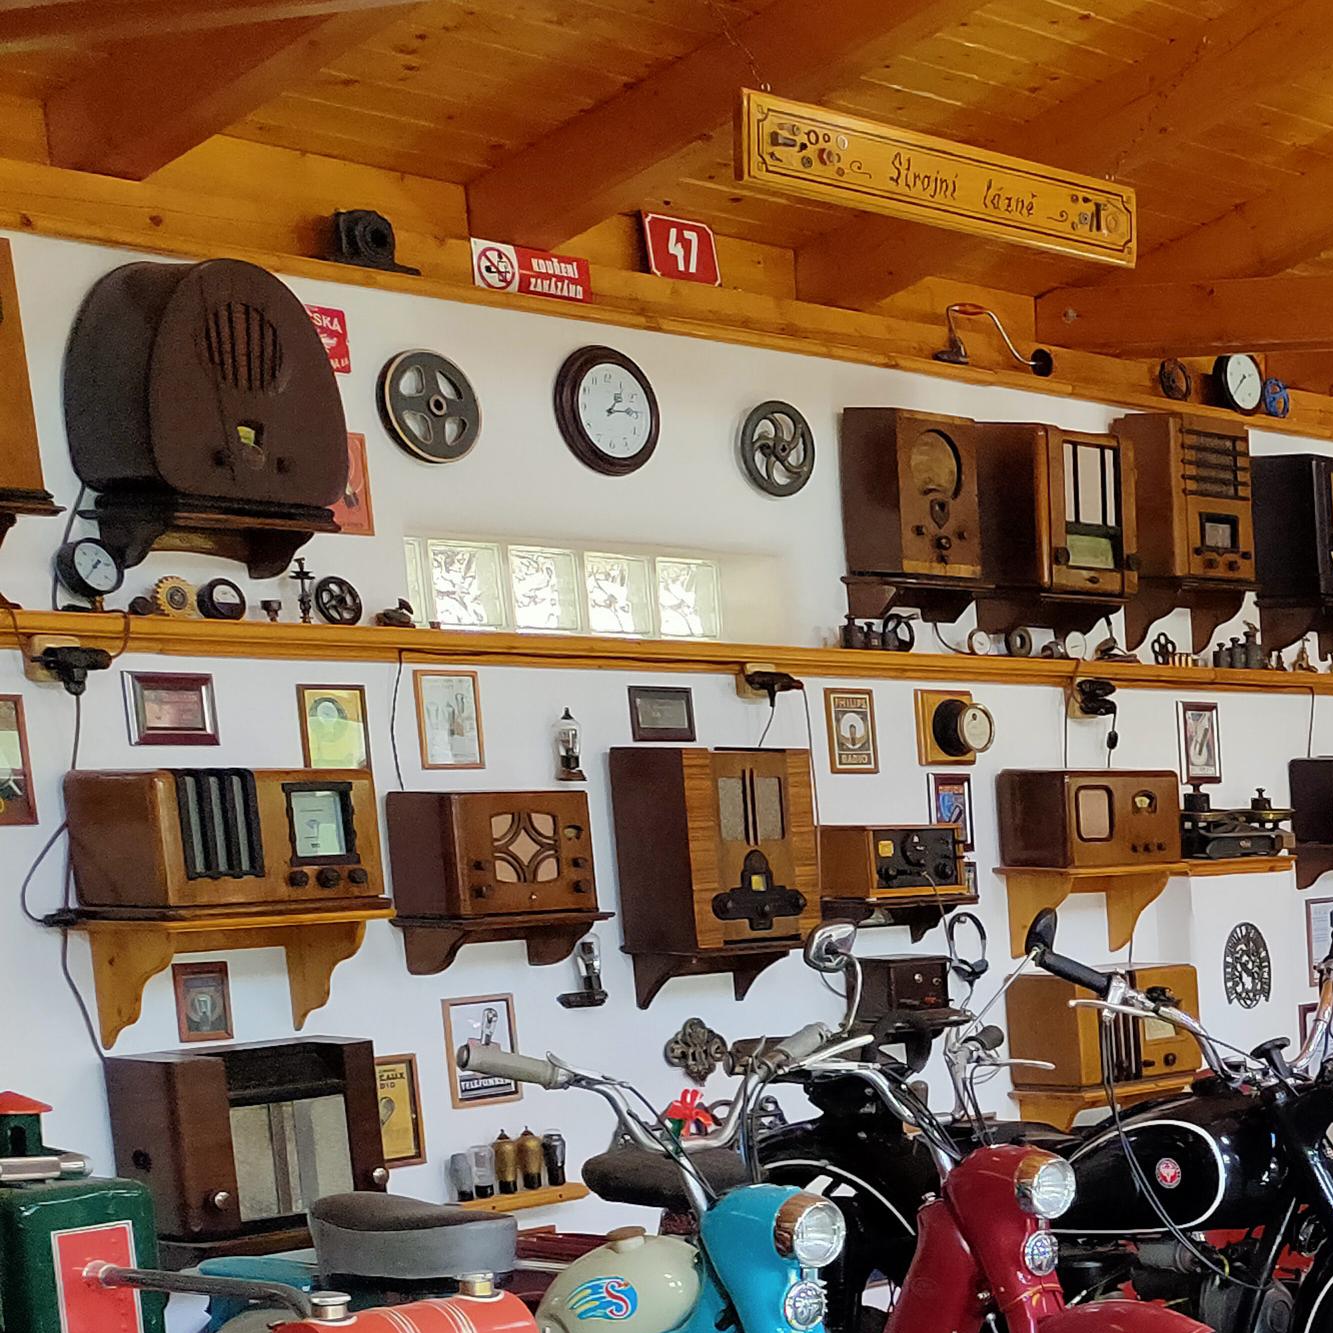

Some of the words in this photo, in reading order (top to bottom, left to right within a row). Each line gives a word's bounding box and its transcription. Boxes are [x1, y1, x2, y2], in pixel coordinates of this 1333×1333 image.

[889, 151, 959, 200] Strojní
[982, 178, 1038, 217] lázně
[667, 227, 699, 273] 47
[530, 257, 579, 279] KOUŘENÍ
[529, 277, 584, 300] ZAKÁZÁNO
[313, 311, 344, 334] SKA
